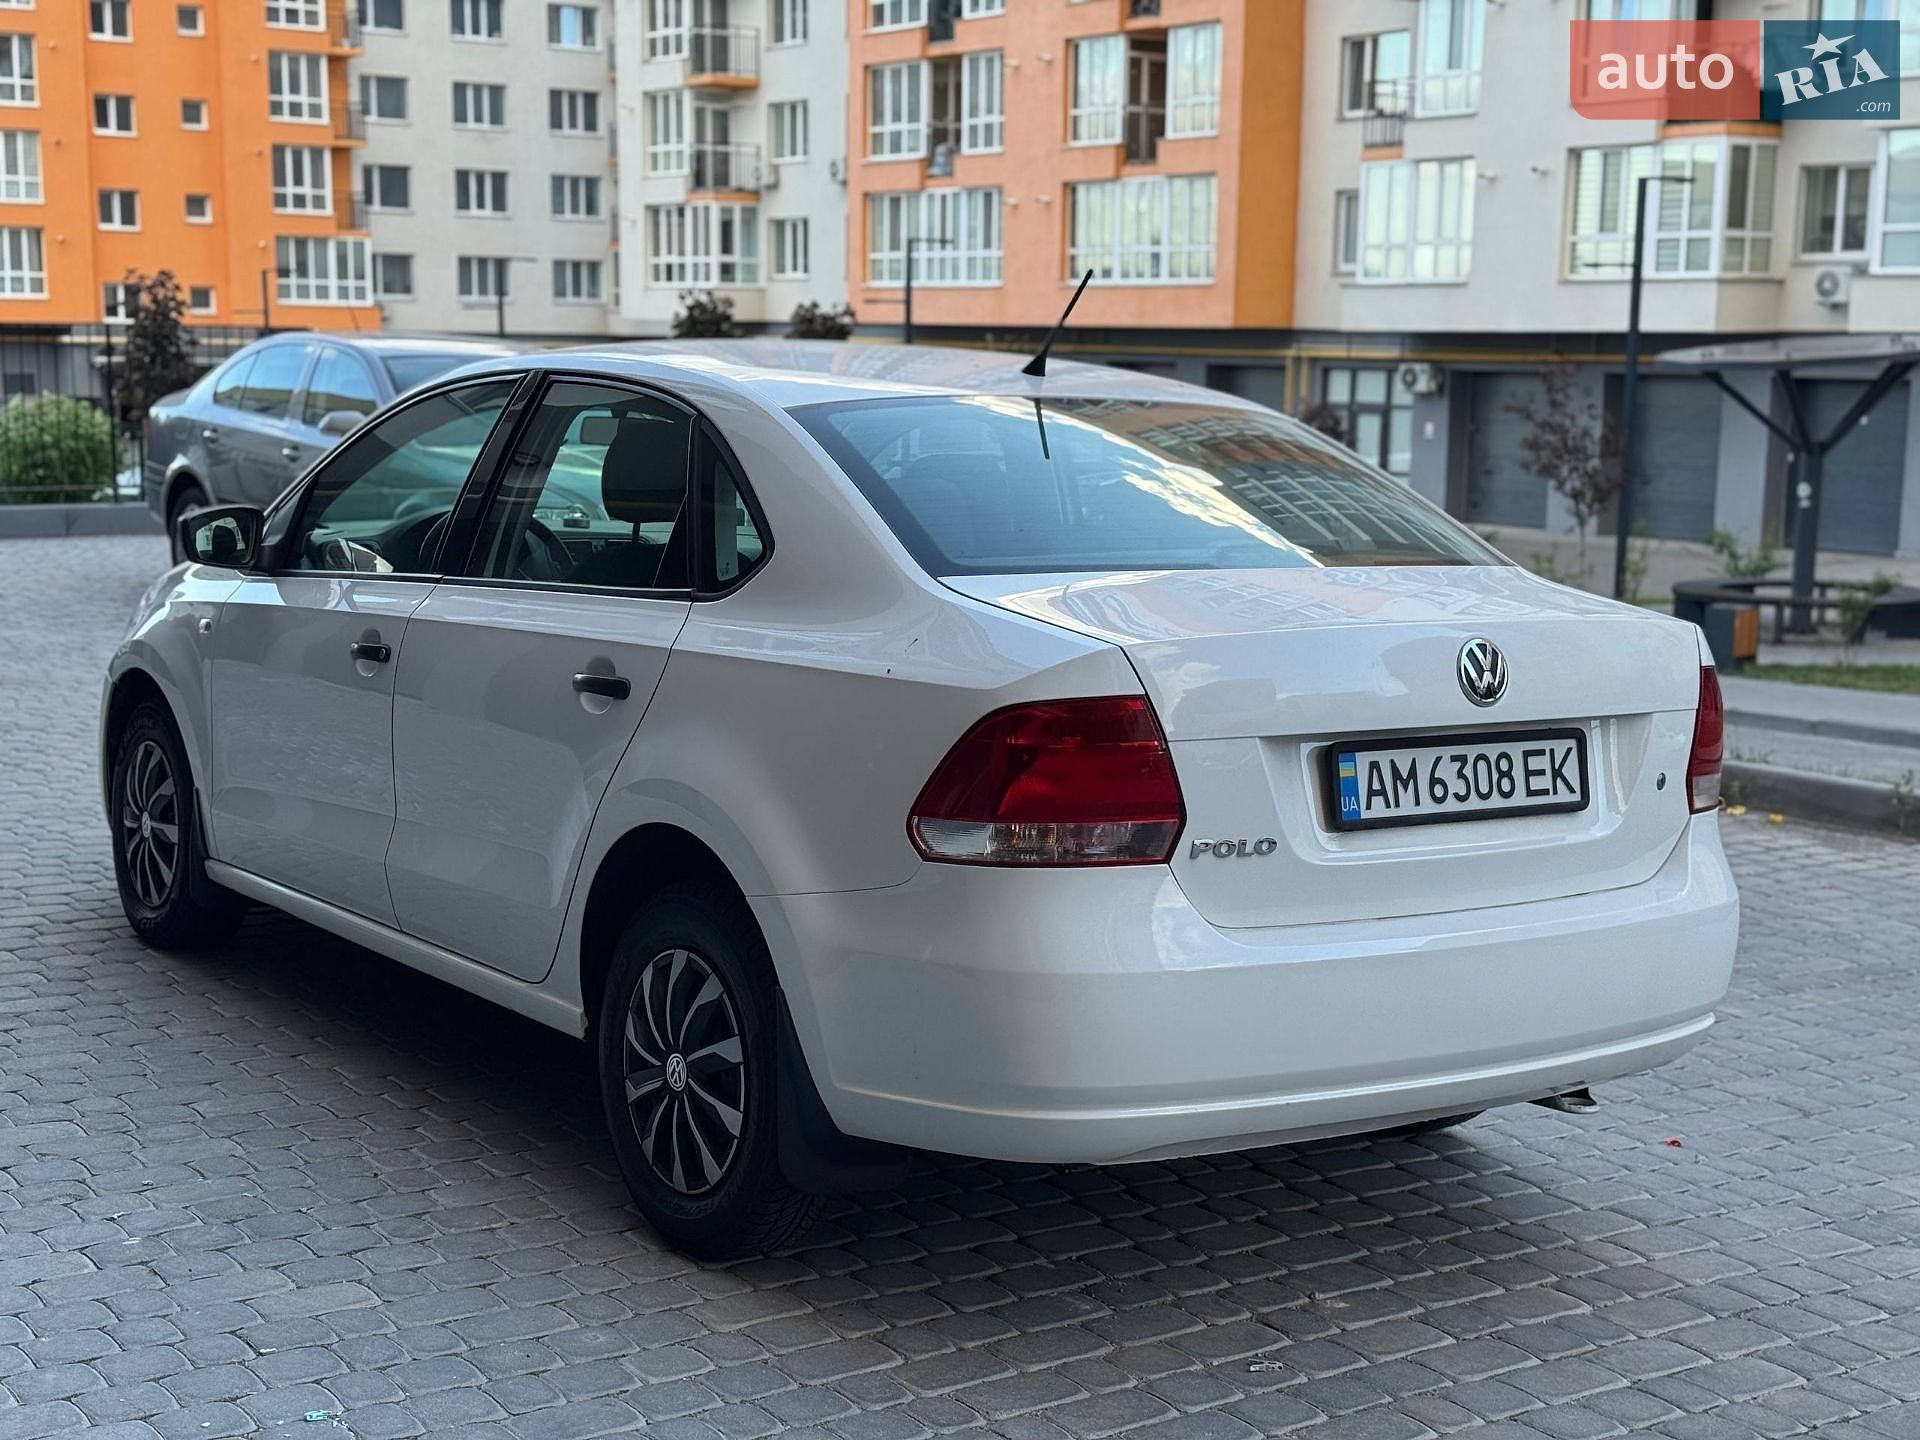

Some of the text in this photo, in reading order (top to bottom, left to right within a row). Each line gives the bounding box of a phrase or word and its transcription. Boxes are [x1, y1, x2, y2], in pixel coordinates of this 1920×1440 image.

[1428, 751, 1516, 805] 6308
[1341, 796, 1359, 812] UA
[1189, 837, 1278, 860] POLO
